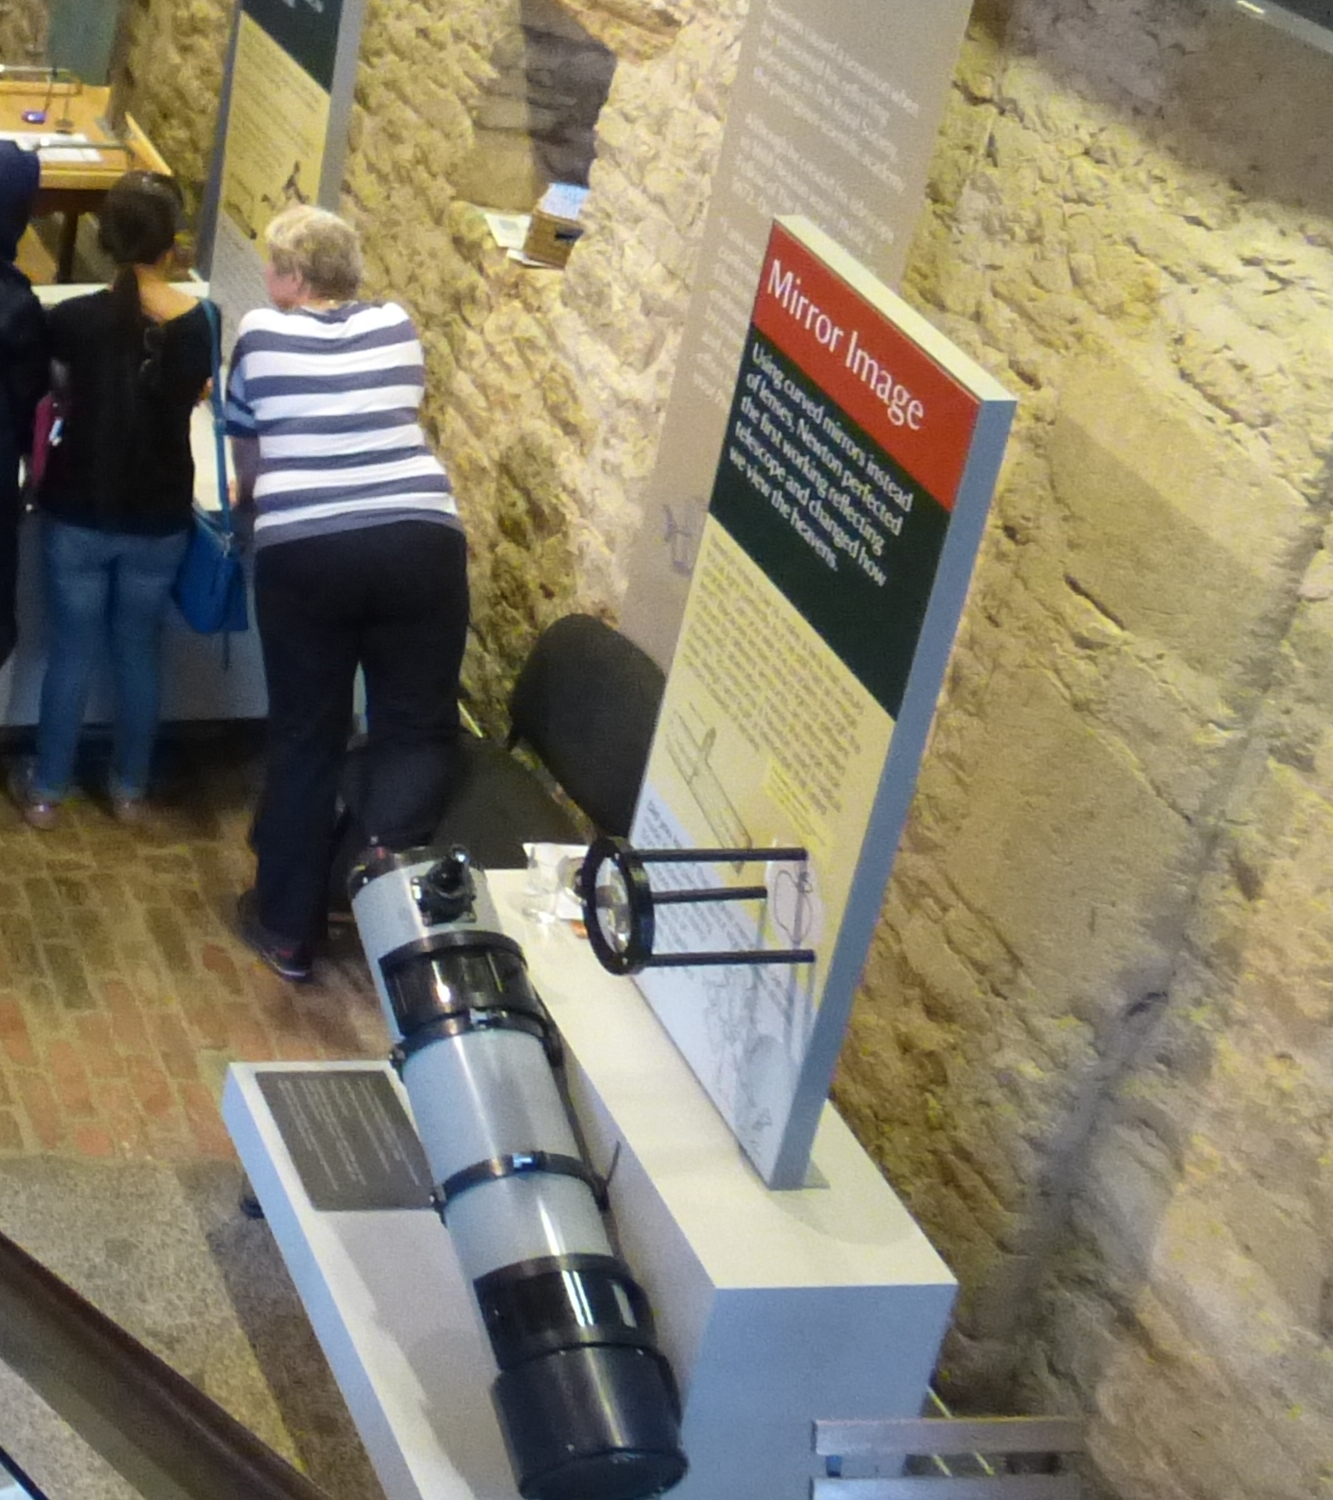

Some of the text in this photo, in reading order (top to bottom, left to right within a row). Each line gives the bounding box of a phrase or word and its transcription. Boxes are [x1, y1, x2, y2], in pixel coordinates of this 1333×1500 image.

[752, 342, 914, 513] Using curved mirrors instead
[766, 260, 844, 353] Mirror
[845, 332, 925, 431] Image
[735, 420, 887, 587] telescope and changed how
[741, 396, 760, 425] the
[783, 439, 829, 498] working
[827, 487, 885, 557] reflecting
[771, 490, 792, 519] the
[796, 418, 842, 477] Newton
[842, 470, 903, 537] perfected
